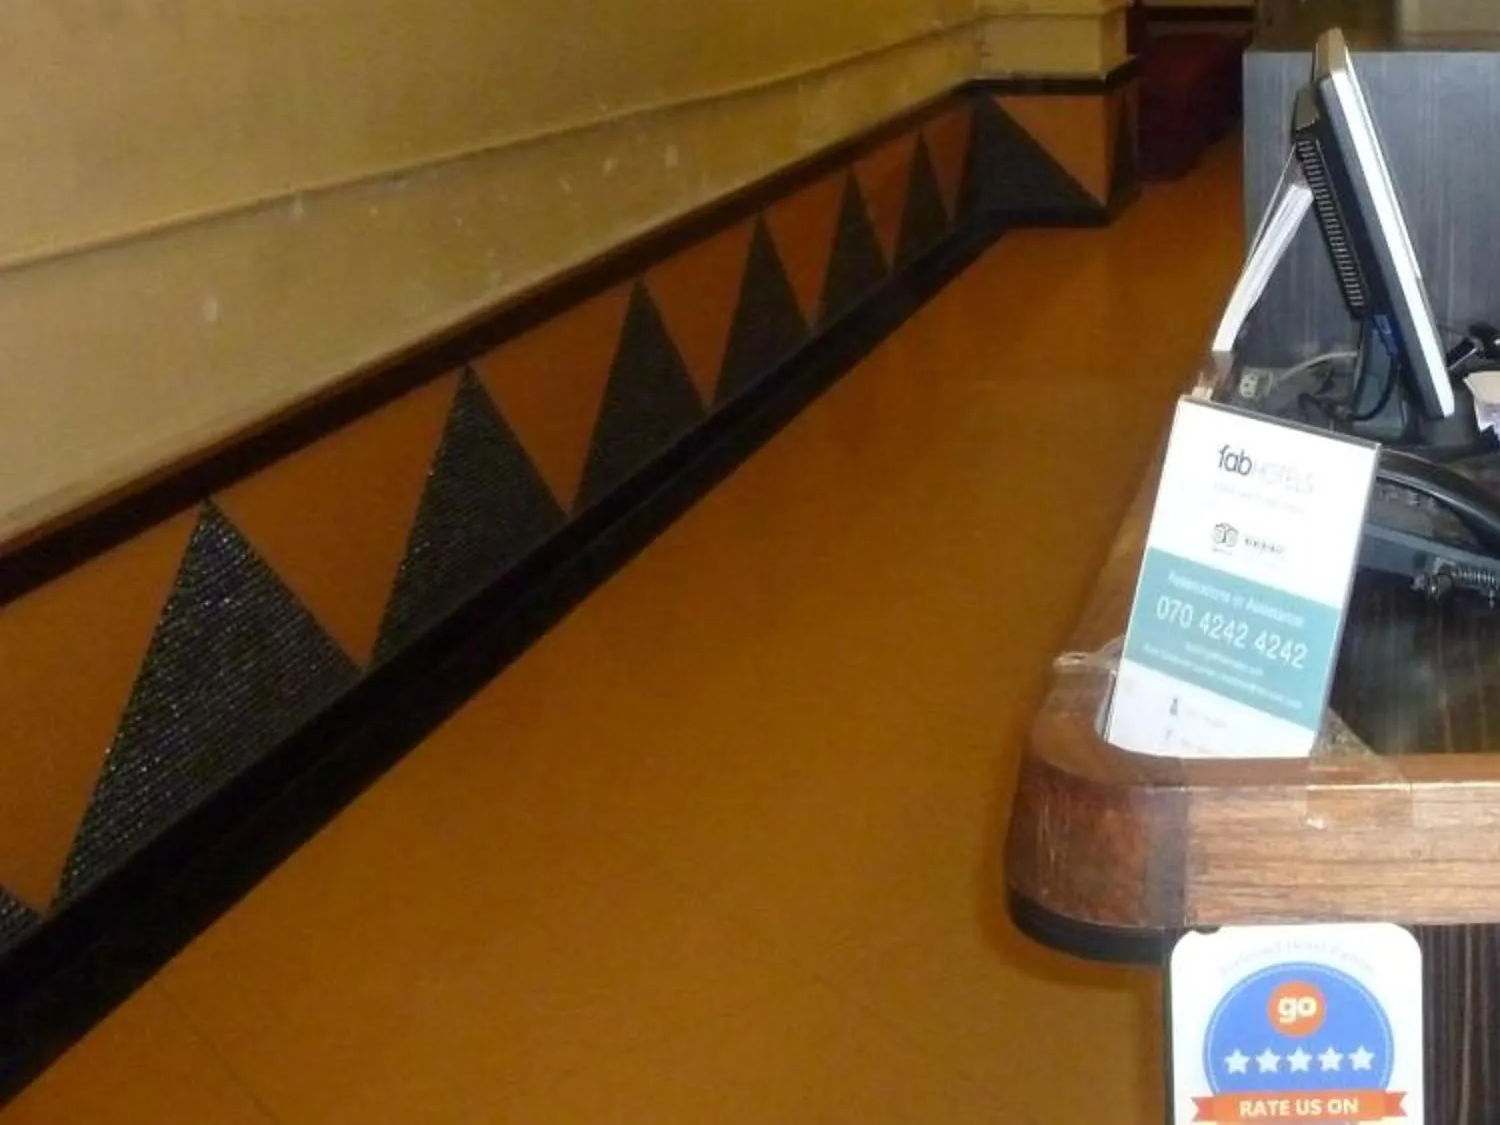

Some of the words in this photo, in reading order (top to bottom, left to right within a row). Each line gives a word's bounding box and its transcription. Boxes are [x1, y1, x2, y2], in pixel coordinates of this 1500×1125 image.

[1156, 595, 1193, 629] 070
[1199, 611, 1247, 648] 4242
[1253, 628, 1308, 669] 4242
[1277, 996, 1318, 1024] go
[1239, 1099, 1290, 1116] RATE
[1296, 1098, 1321, 1115] US
[1327, 1098, 1359, 1115] ON
